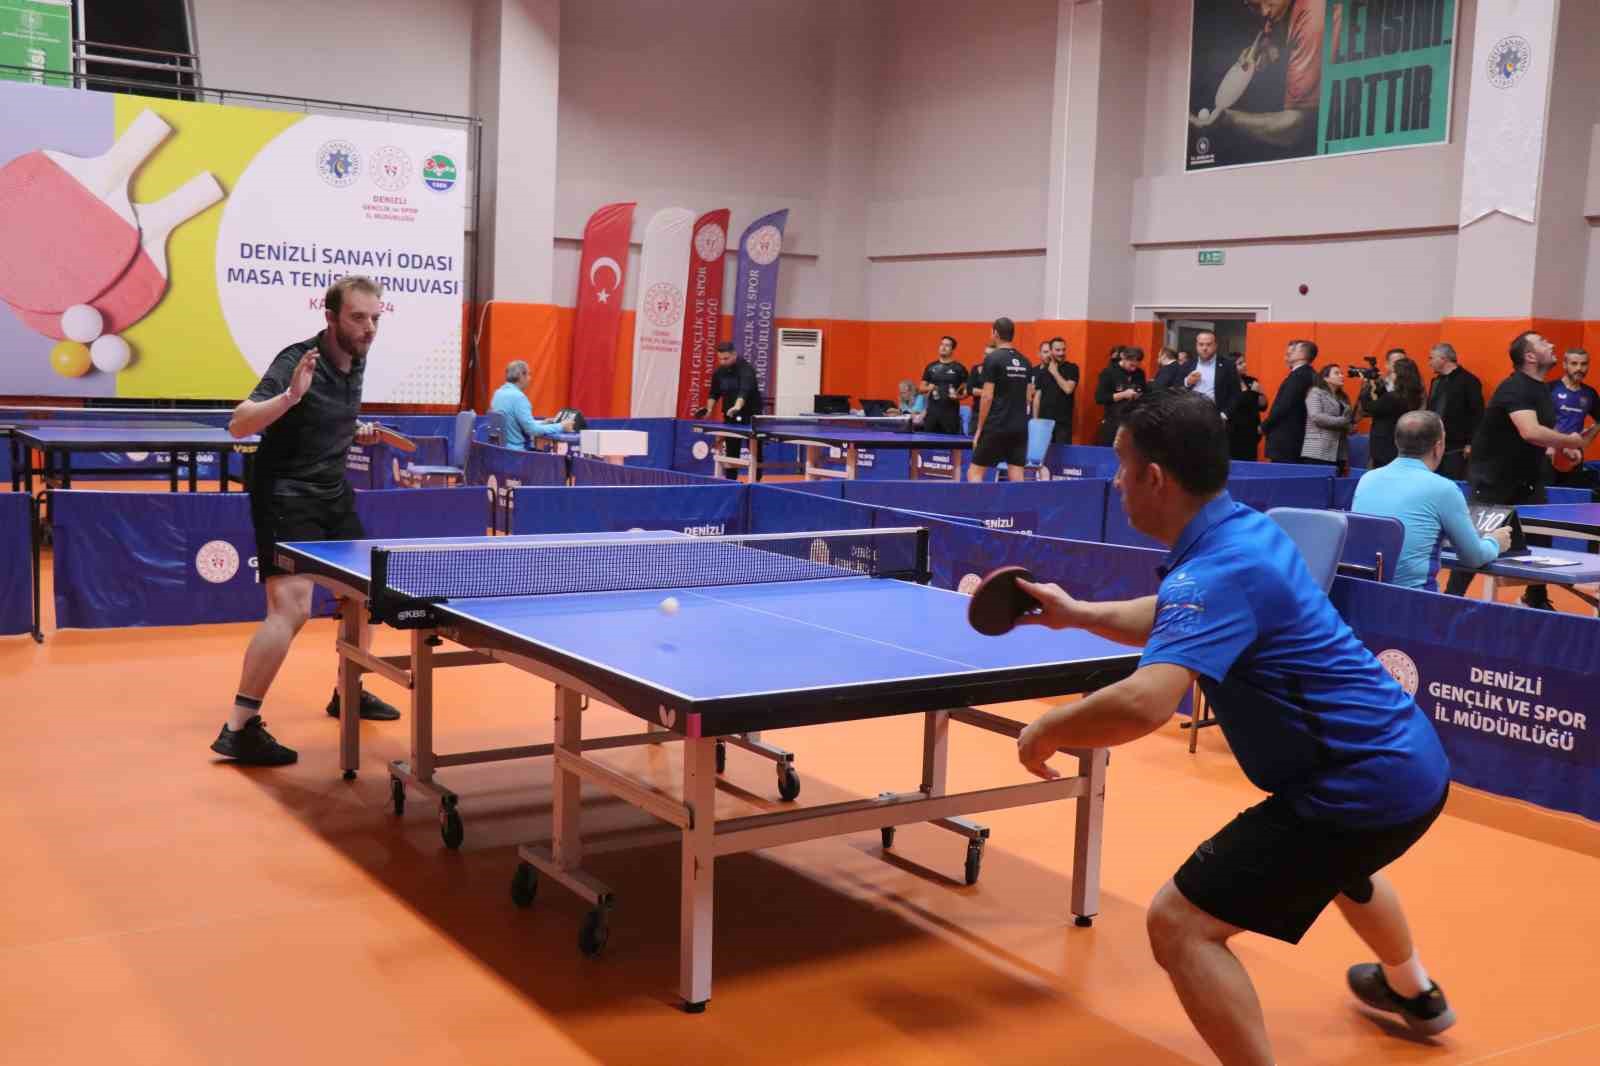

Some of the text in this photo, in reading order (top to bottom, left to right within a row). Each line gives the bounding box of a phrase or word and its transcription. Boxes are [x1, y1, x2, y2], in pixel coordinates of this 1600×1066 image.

[1325, 64, 1432, 141] ARTTIR
[240, 241, 452, 271] DENİZLİ SANAYİ ODASI
[227, 267, 284, 285] MASA
[367, 275, 458, 295] RNUVASI
[746, 270, 760, 300] SPOR
[745, 302, 757, 317] VE
[984, 516, 1013, 529] ENİZLİ
[1470, 667, 1542, 696] DENİZLİ
[1428, 682, 1587, 730] GENÇLİK VE SPOR
[1434, 702, 1575, 751] İL MÜDÜRLÜĞÜ
